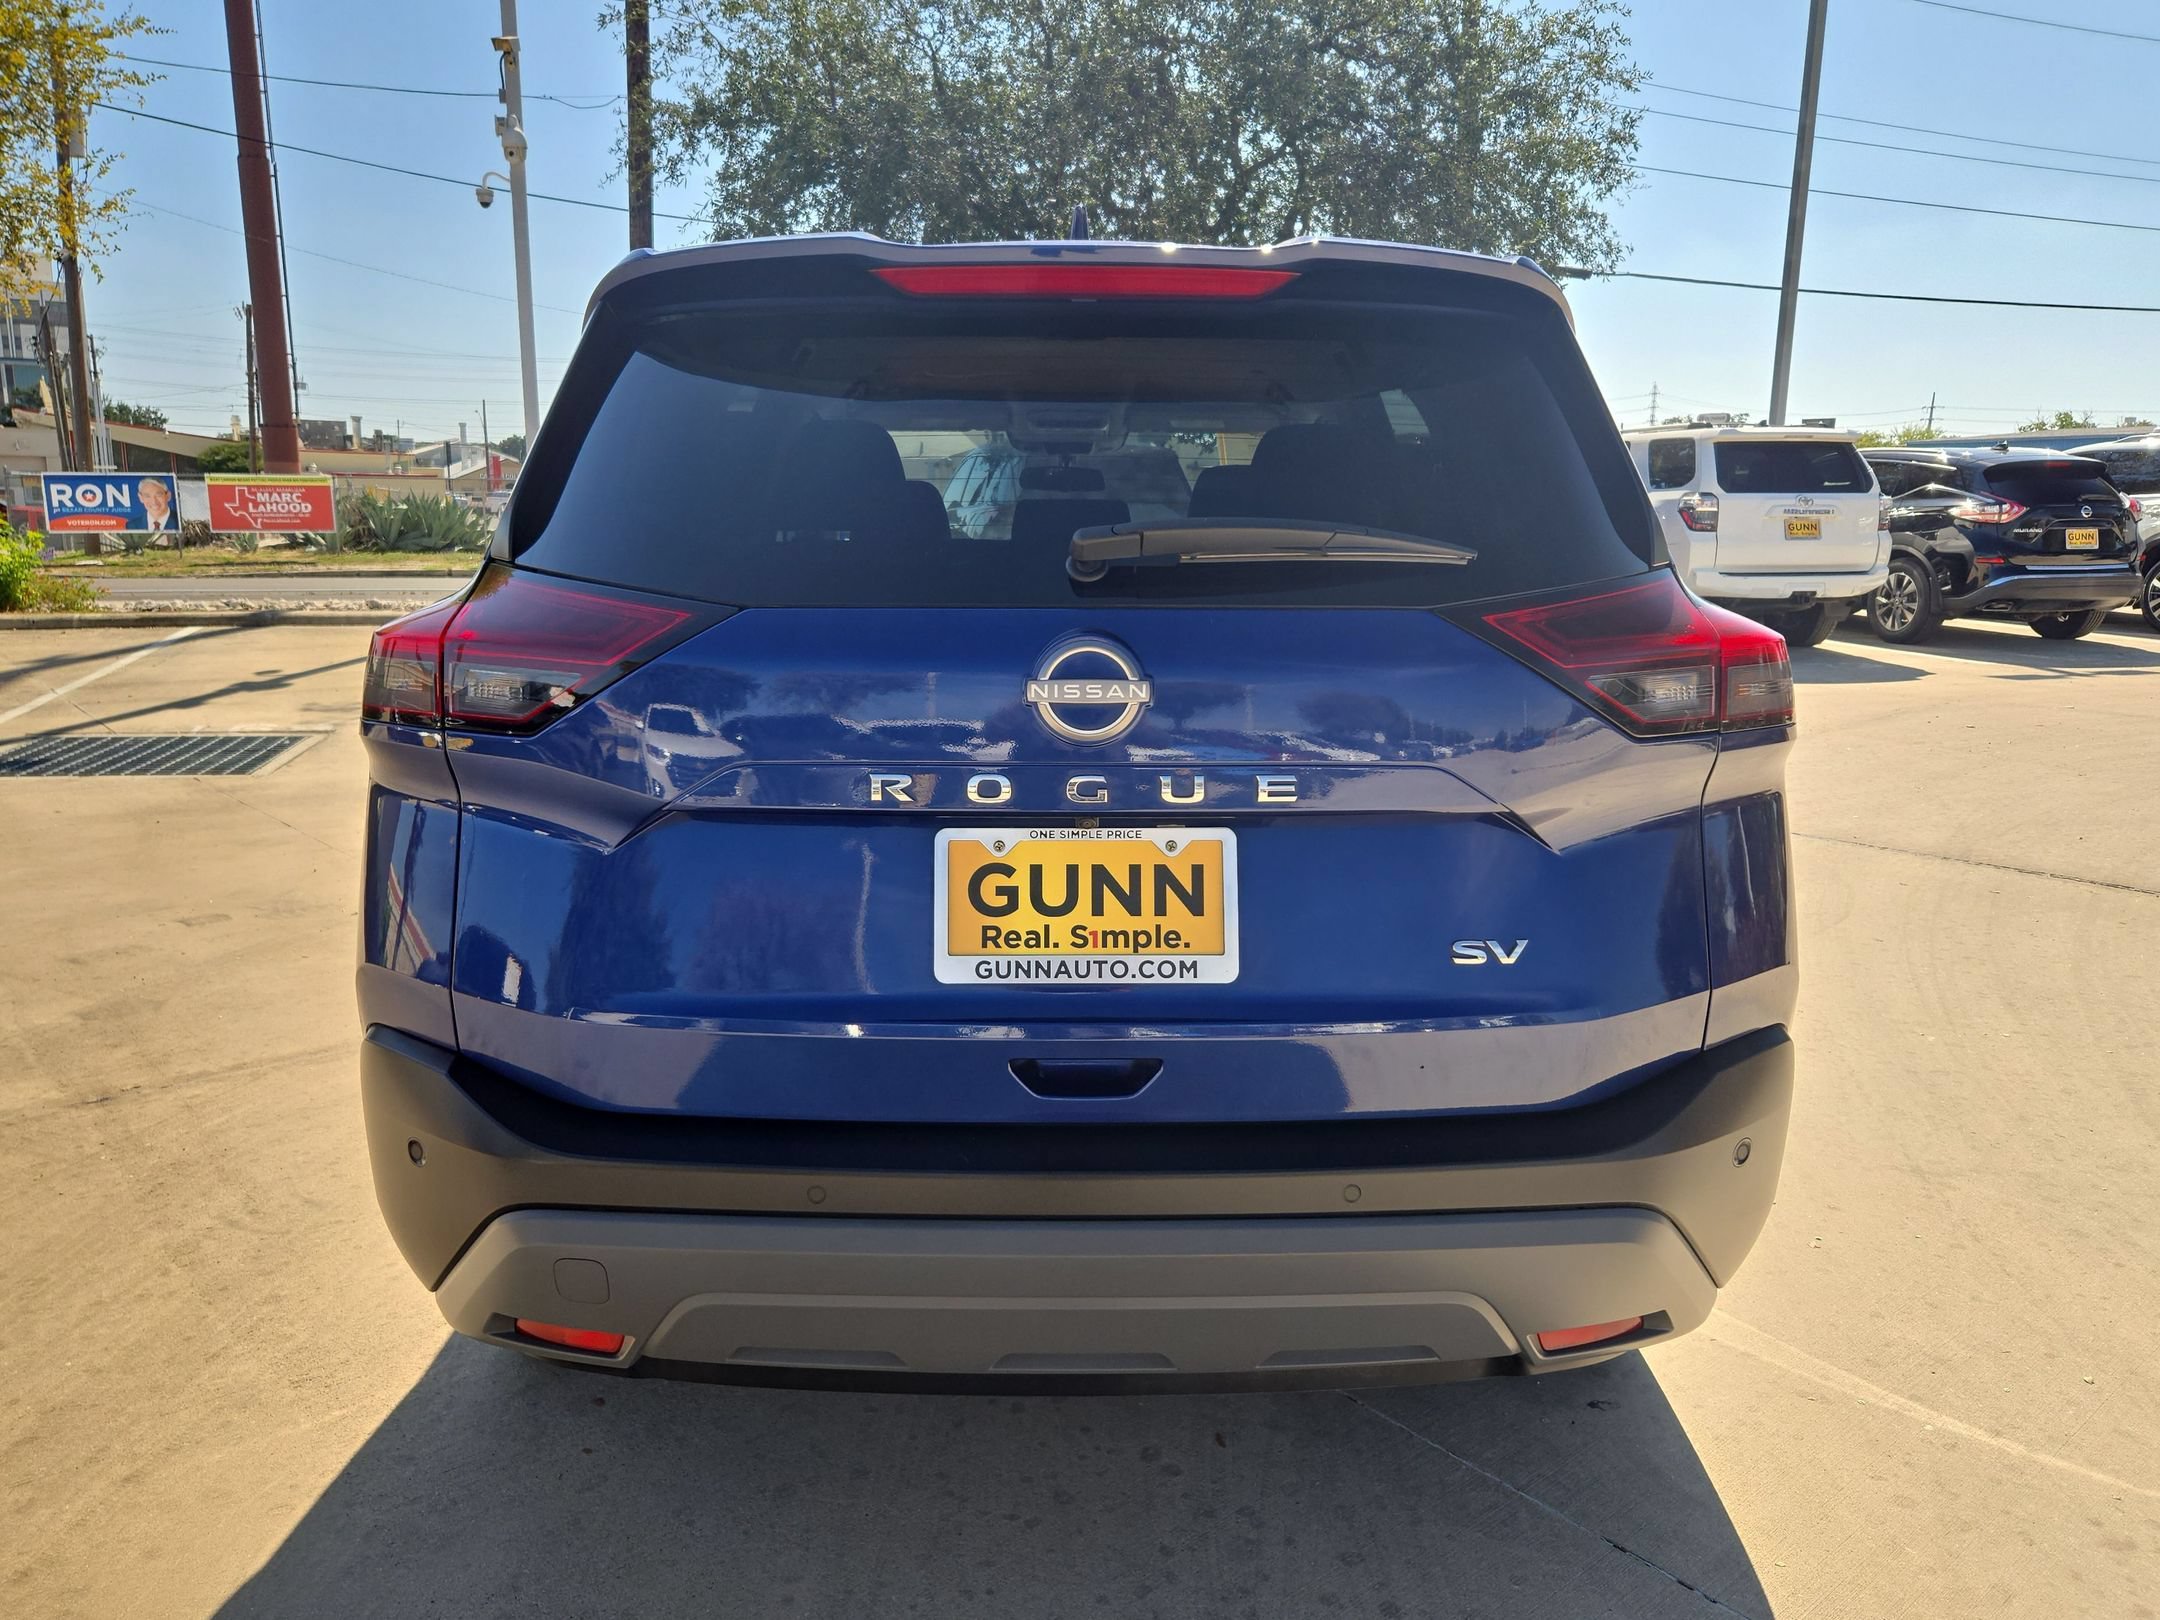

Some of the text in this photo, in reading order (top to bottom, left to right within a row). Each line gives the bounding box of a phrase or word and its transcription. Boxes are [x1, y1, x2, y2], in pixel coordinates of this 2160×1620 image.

[50, 483, 131, 508] RON
[256, 492, 302, 503] MARC
[1788, 523, 1817, 531] GUNN
[2068, 533, 2094, 541] GUNN
[1030, 683, 1148, 699] NISSAN
[869, 773, 1299, 804] ROGUE
[1029, 830, 1143, 839] ONE SIMPLE PRICE
[967, 862, 1205, 918] GUNN
[981, 924, 1060, 949] Real.
[1452, 939, 1529, 965] SV
[974, 960, 1199, 980] GUNNAUTO.COM
